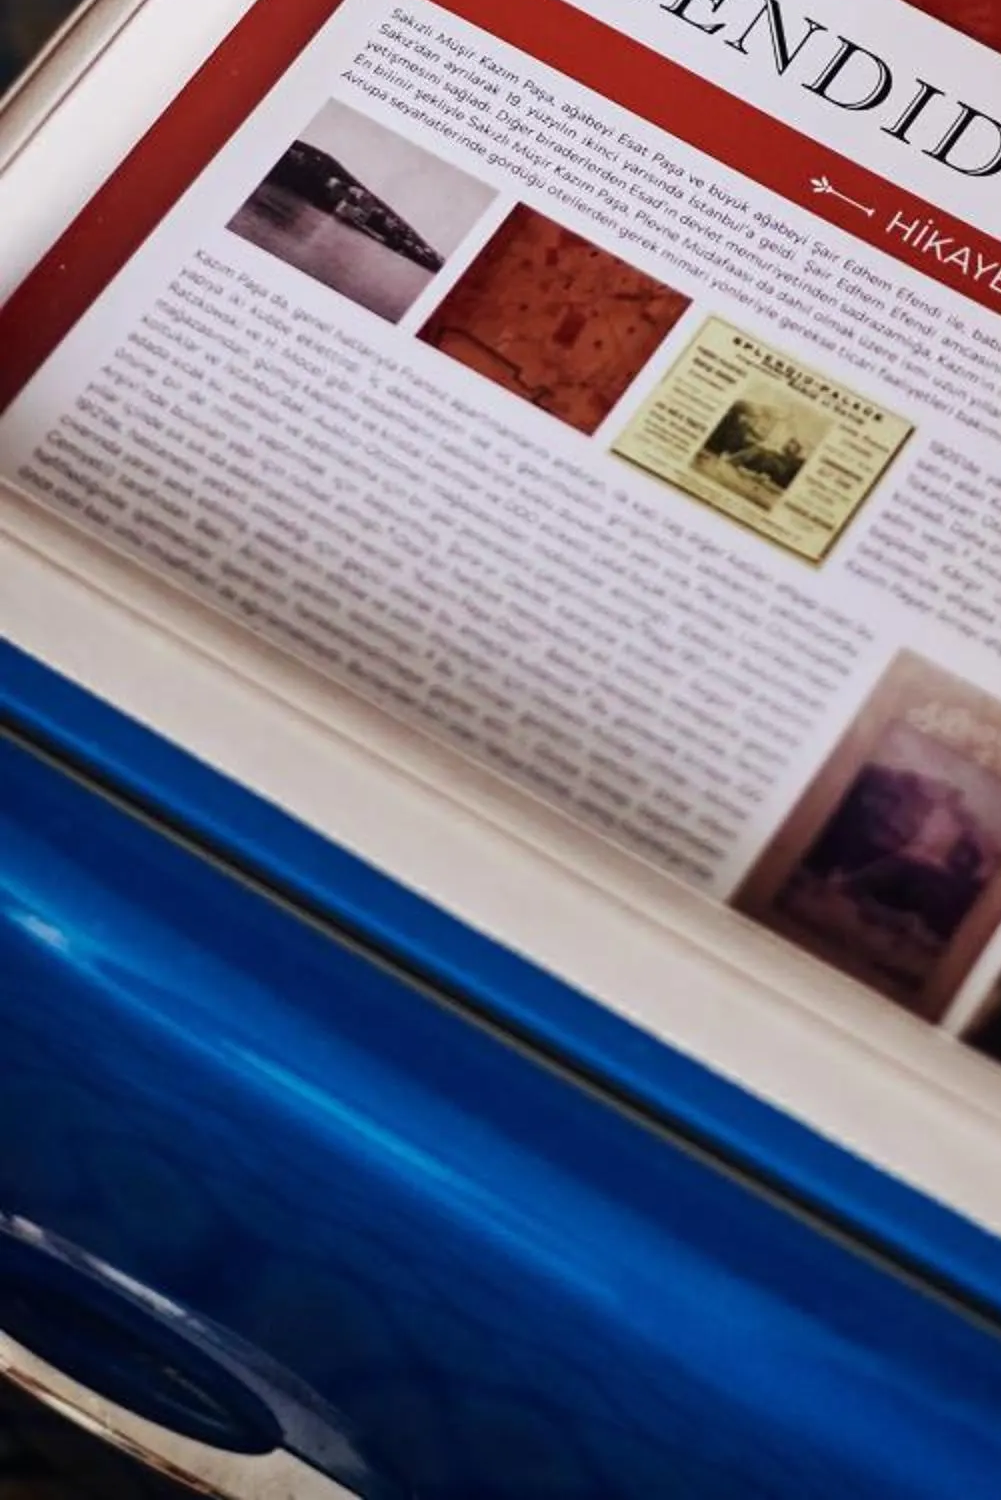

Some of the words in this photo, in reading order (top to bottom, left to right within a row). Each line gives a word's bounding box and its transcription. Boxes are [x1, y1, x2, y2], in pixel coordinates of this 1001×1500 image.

[339, 68, 389, 101] Avrupa
[615, 226, 661, 252] gerek
[351, 52, 373, 69] En
[372, 64, 413, 92] bilinir
[551, 164, 596, 194] Kazım
[441, 61, 502, 96] ayrılarak
[579, 135, 621, 162] ikinci
[619, 160, 685, 199] yarısında
[800, 259, 832, 281] Şair
[834, 277, 887, 311] Edhem
[888, 305, 938, 338] Efendi
[477, 55, 519, 84] Kazım
[616, 133, 650, 157] Esat
[650, 152, 685, 177] Paşa
[685, 174, 706, 189] ve
[807, 240, 840, 263] Şair
[841, 258, 894, 292] Edhem
[894, 286, 945, 319] Efendi
[533, 132, 628, 188] biraderlerden
[677, 211, 725, 242] devlet
